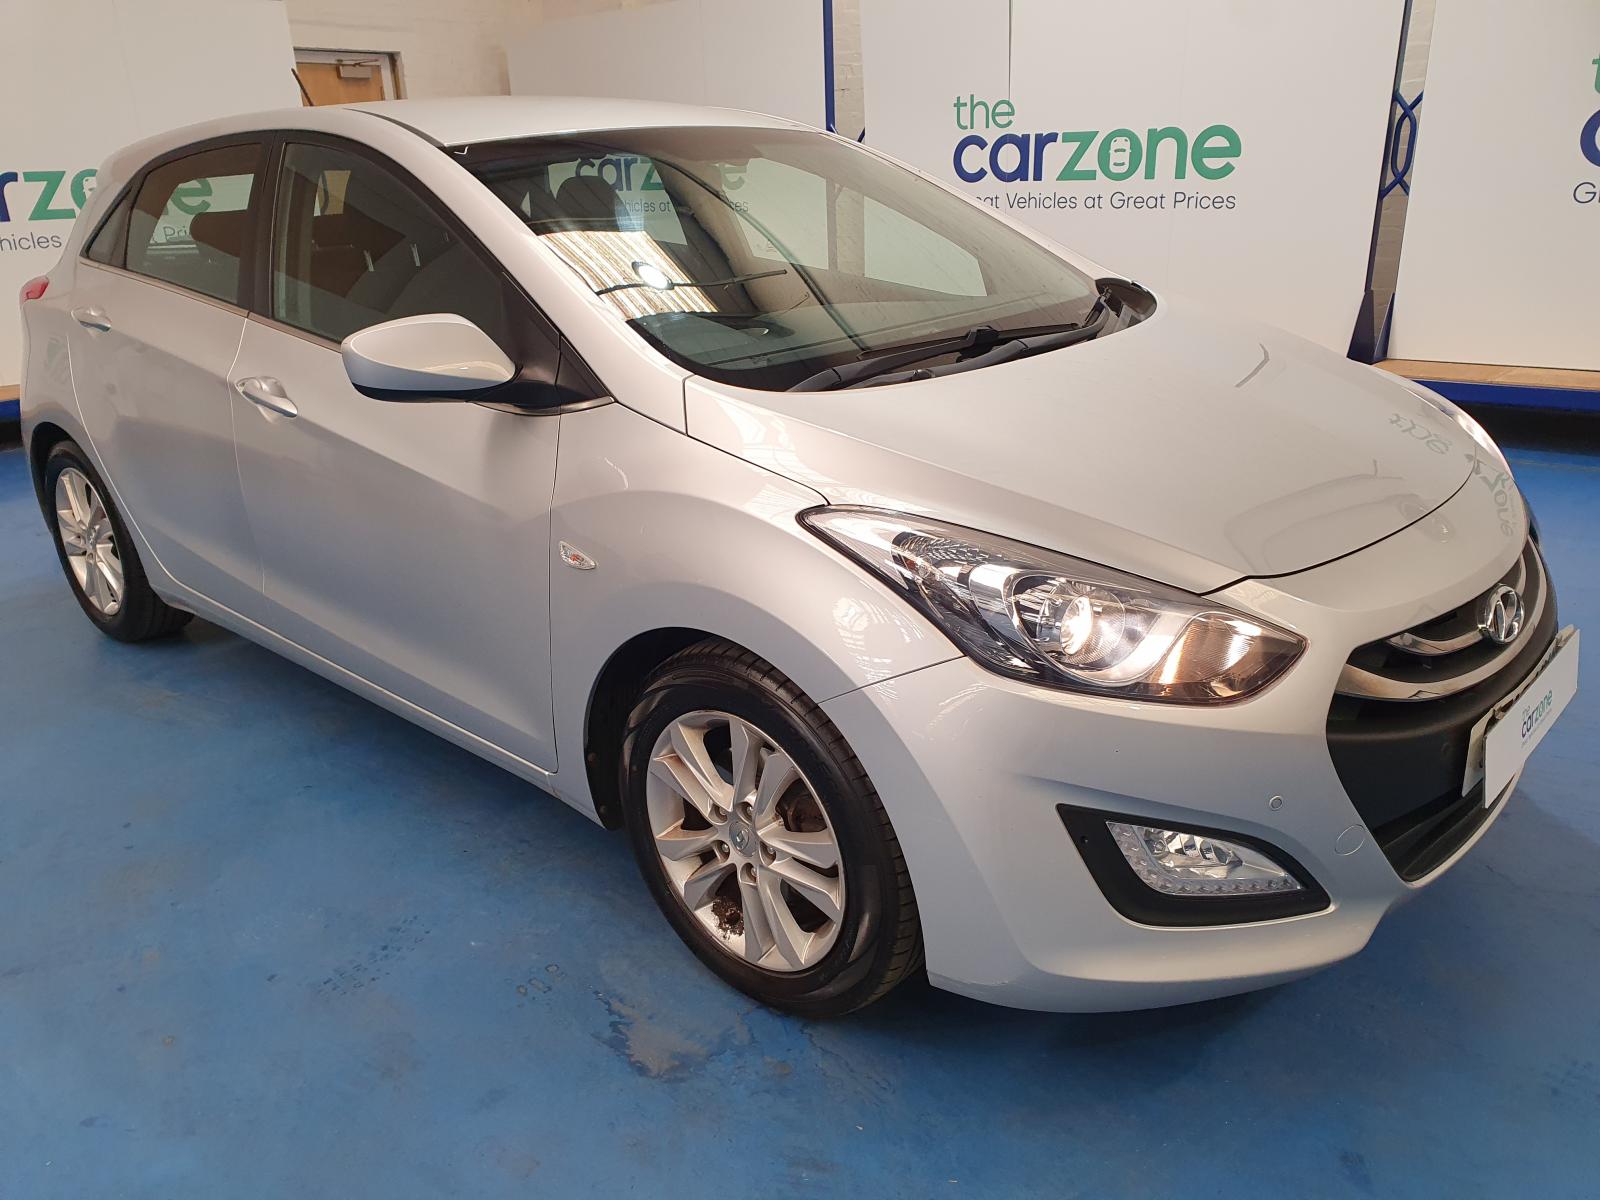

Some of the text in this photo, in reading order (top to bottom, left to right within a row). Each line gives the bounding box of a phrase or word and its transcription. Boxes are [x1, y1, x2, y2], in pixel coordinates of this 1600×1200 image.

[953, 94, 1016, 130] the
[953, 125, 1242, 183] carzone
[1006, 192, 1077, 209] Vehicles
[1083, 193, 1103, 209] at
[1110, 191, 1166, 209] Great
[1174, 191, 1236, 209] Prices
